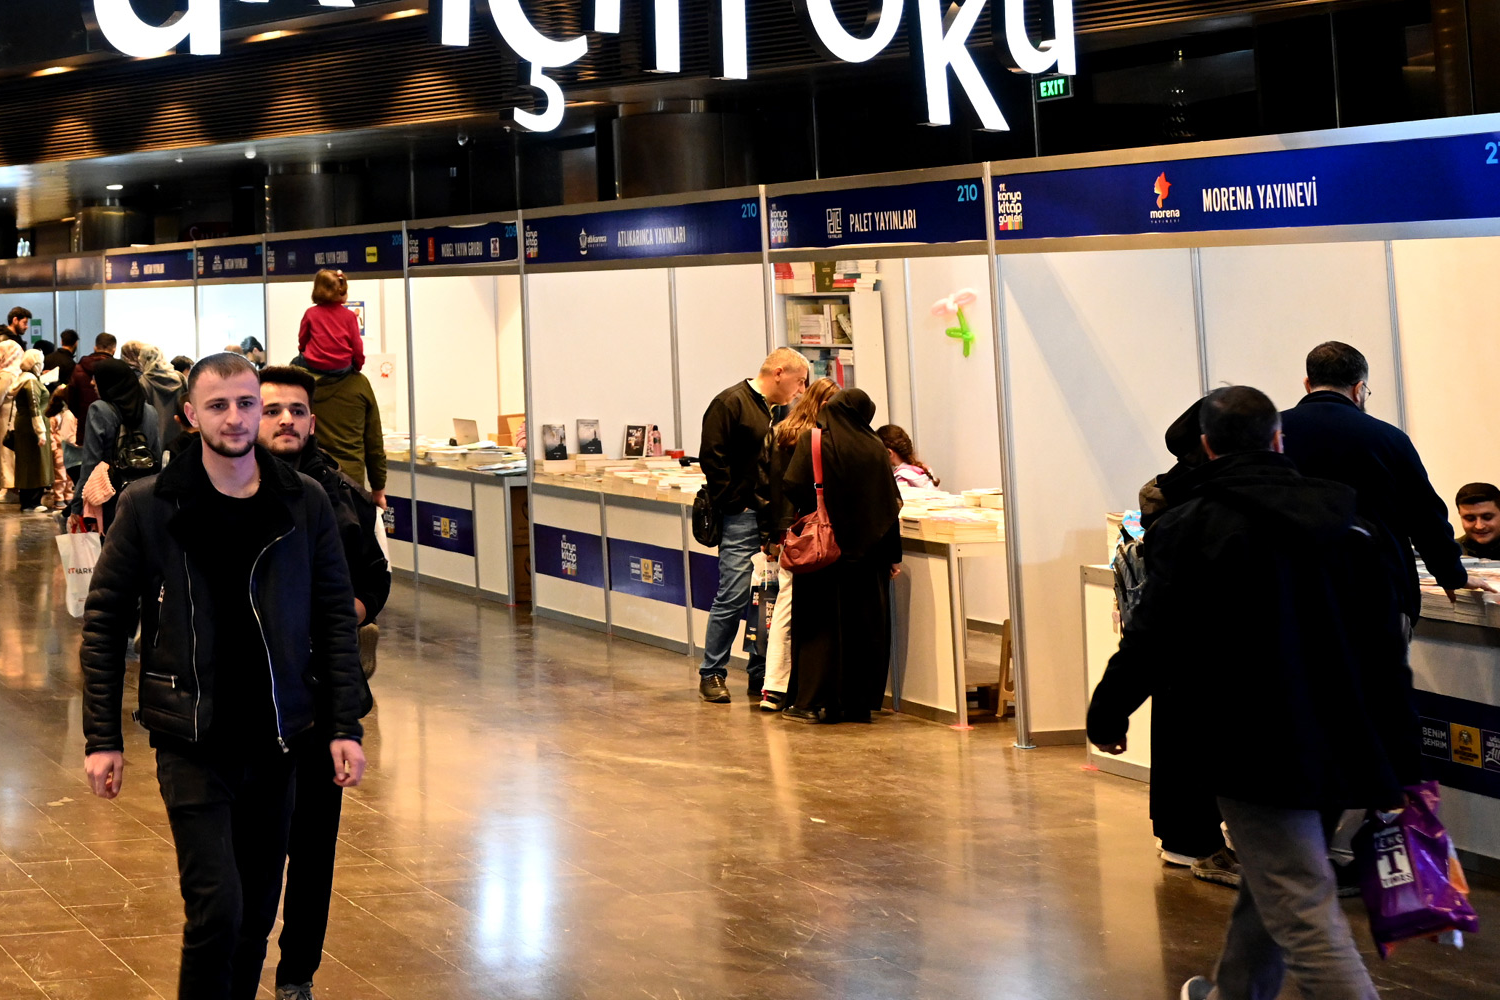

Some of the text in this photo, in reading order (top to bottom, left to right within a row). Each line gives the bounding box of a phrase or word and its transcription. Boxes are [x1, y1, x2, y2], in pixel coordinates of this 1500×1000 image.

[1040, 79, 1064, 97] EXIT
[1485, 141, 1500, 165] 2
[957, 184, 978, 202] 210
[997, 190, 1021, 203] konya
[1202, 176, 1318, 212] MORENA YAYINEVİ
[741, 203, 757, 218] 210
[998, 201, 1022, 215] kitap
[1150, 209, 1180, 219] morena
[849, 209, 916, 232] PALET YAYINLARI
[999, 213, 1022, 225] günleri
[617, 225, 686, 248] ATLIKARINCA YAYINLARI
[1422, 726, 1447, 740] BENİM
